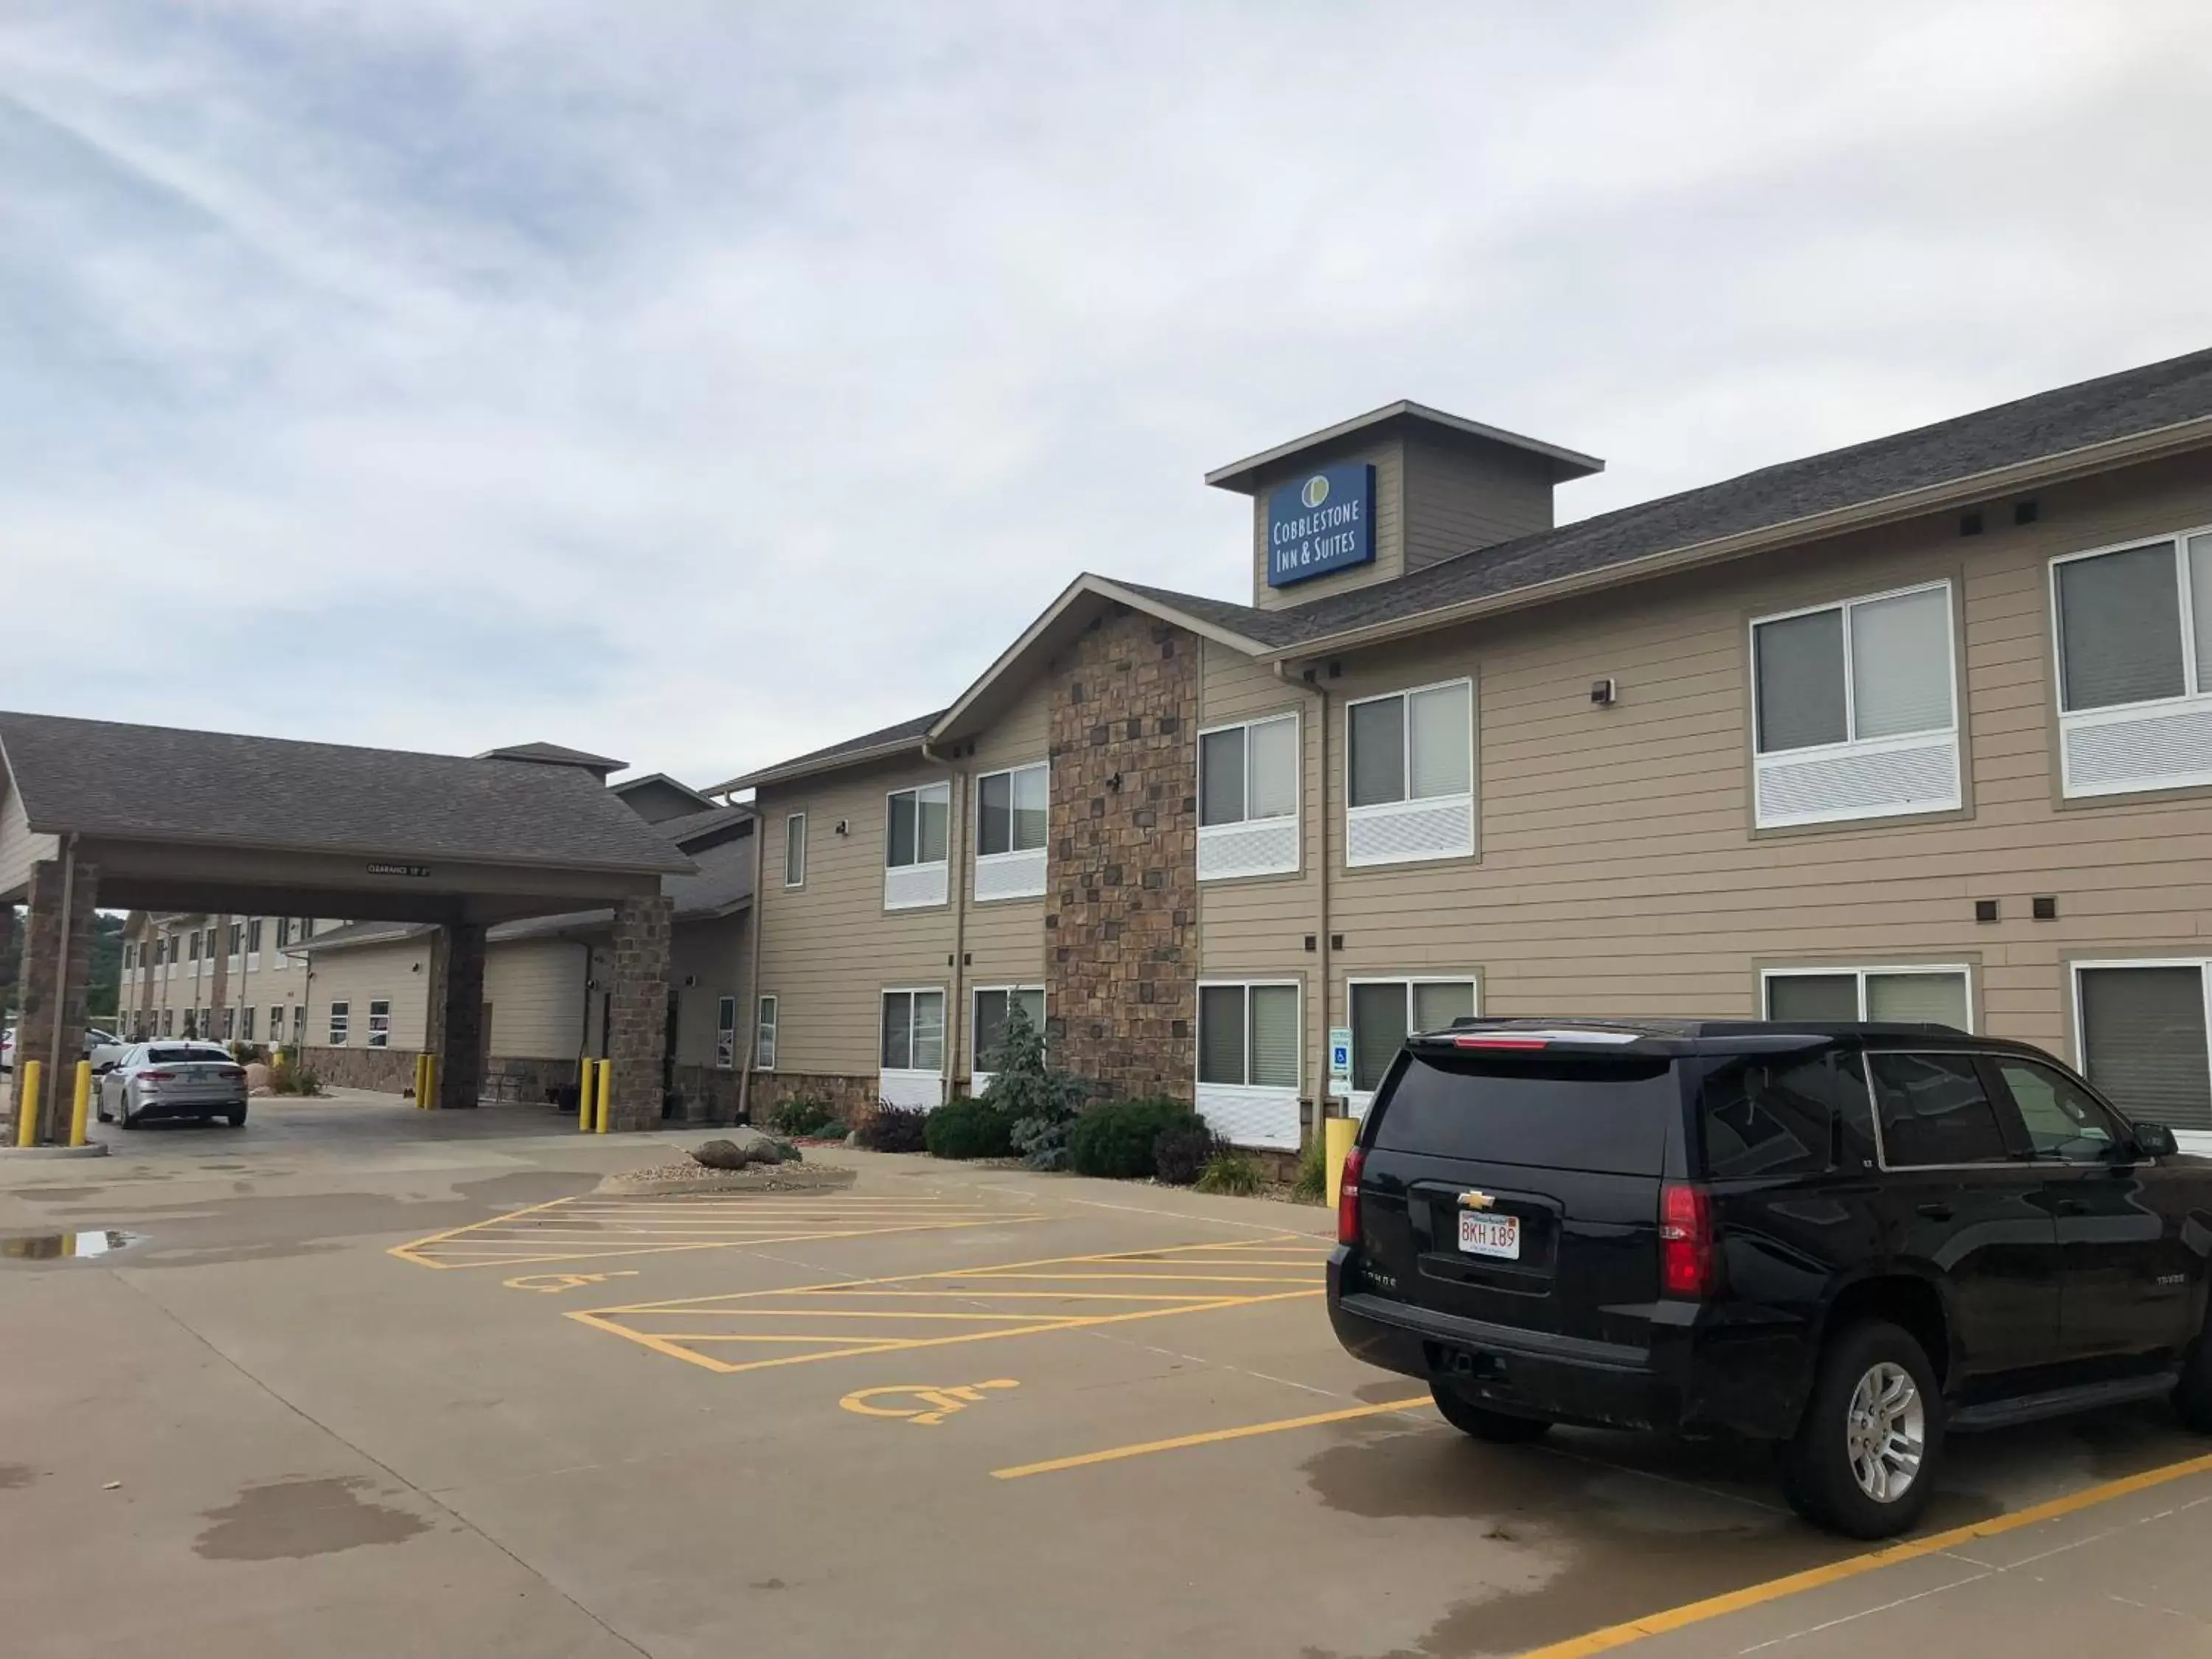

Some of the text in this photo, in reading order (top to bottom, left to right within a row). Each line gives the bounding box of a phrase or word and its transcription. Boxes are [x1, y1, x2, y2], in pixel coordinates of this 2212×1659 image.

[1273, 500, 1359, 545] COBBLESTONE
[1276, 530, 1355, 573] INN & SUITES
[1490, 1226, 1515, 1247] 189
